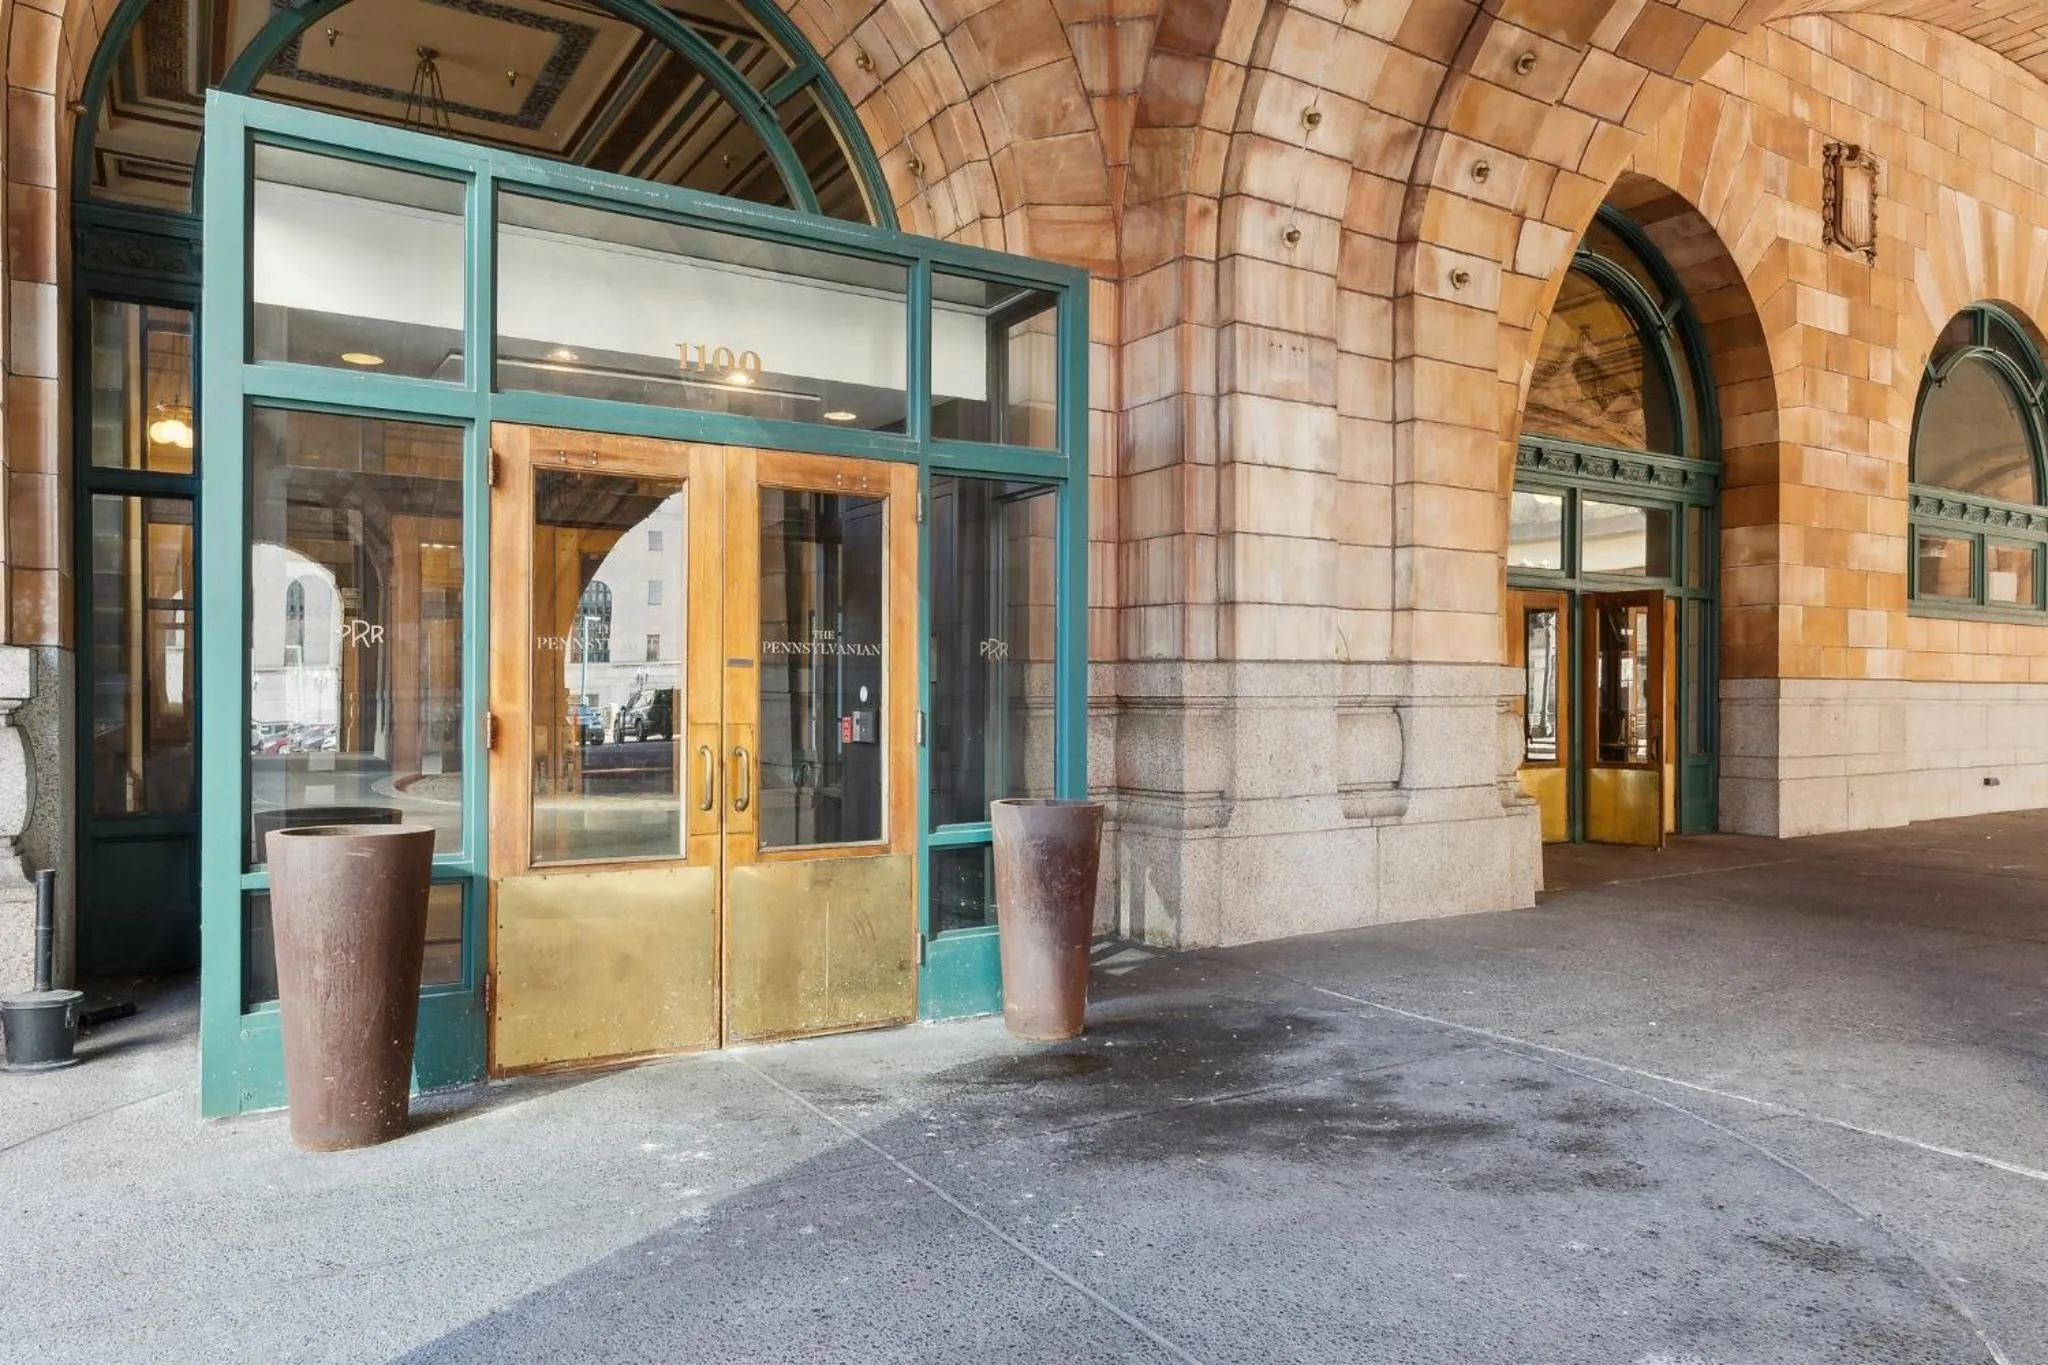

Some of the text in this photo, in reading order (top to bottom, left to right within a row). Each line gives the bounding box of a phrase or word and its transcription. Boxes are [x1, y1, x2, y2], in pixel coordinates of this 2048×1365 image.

[813, 630, 835, 640] THE
[762, 641, 882, 656] PENNSYLVANIAN
[980, 637, 1009, 661] PRR
